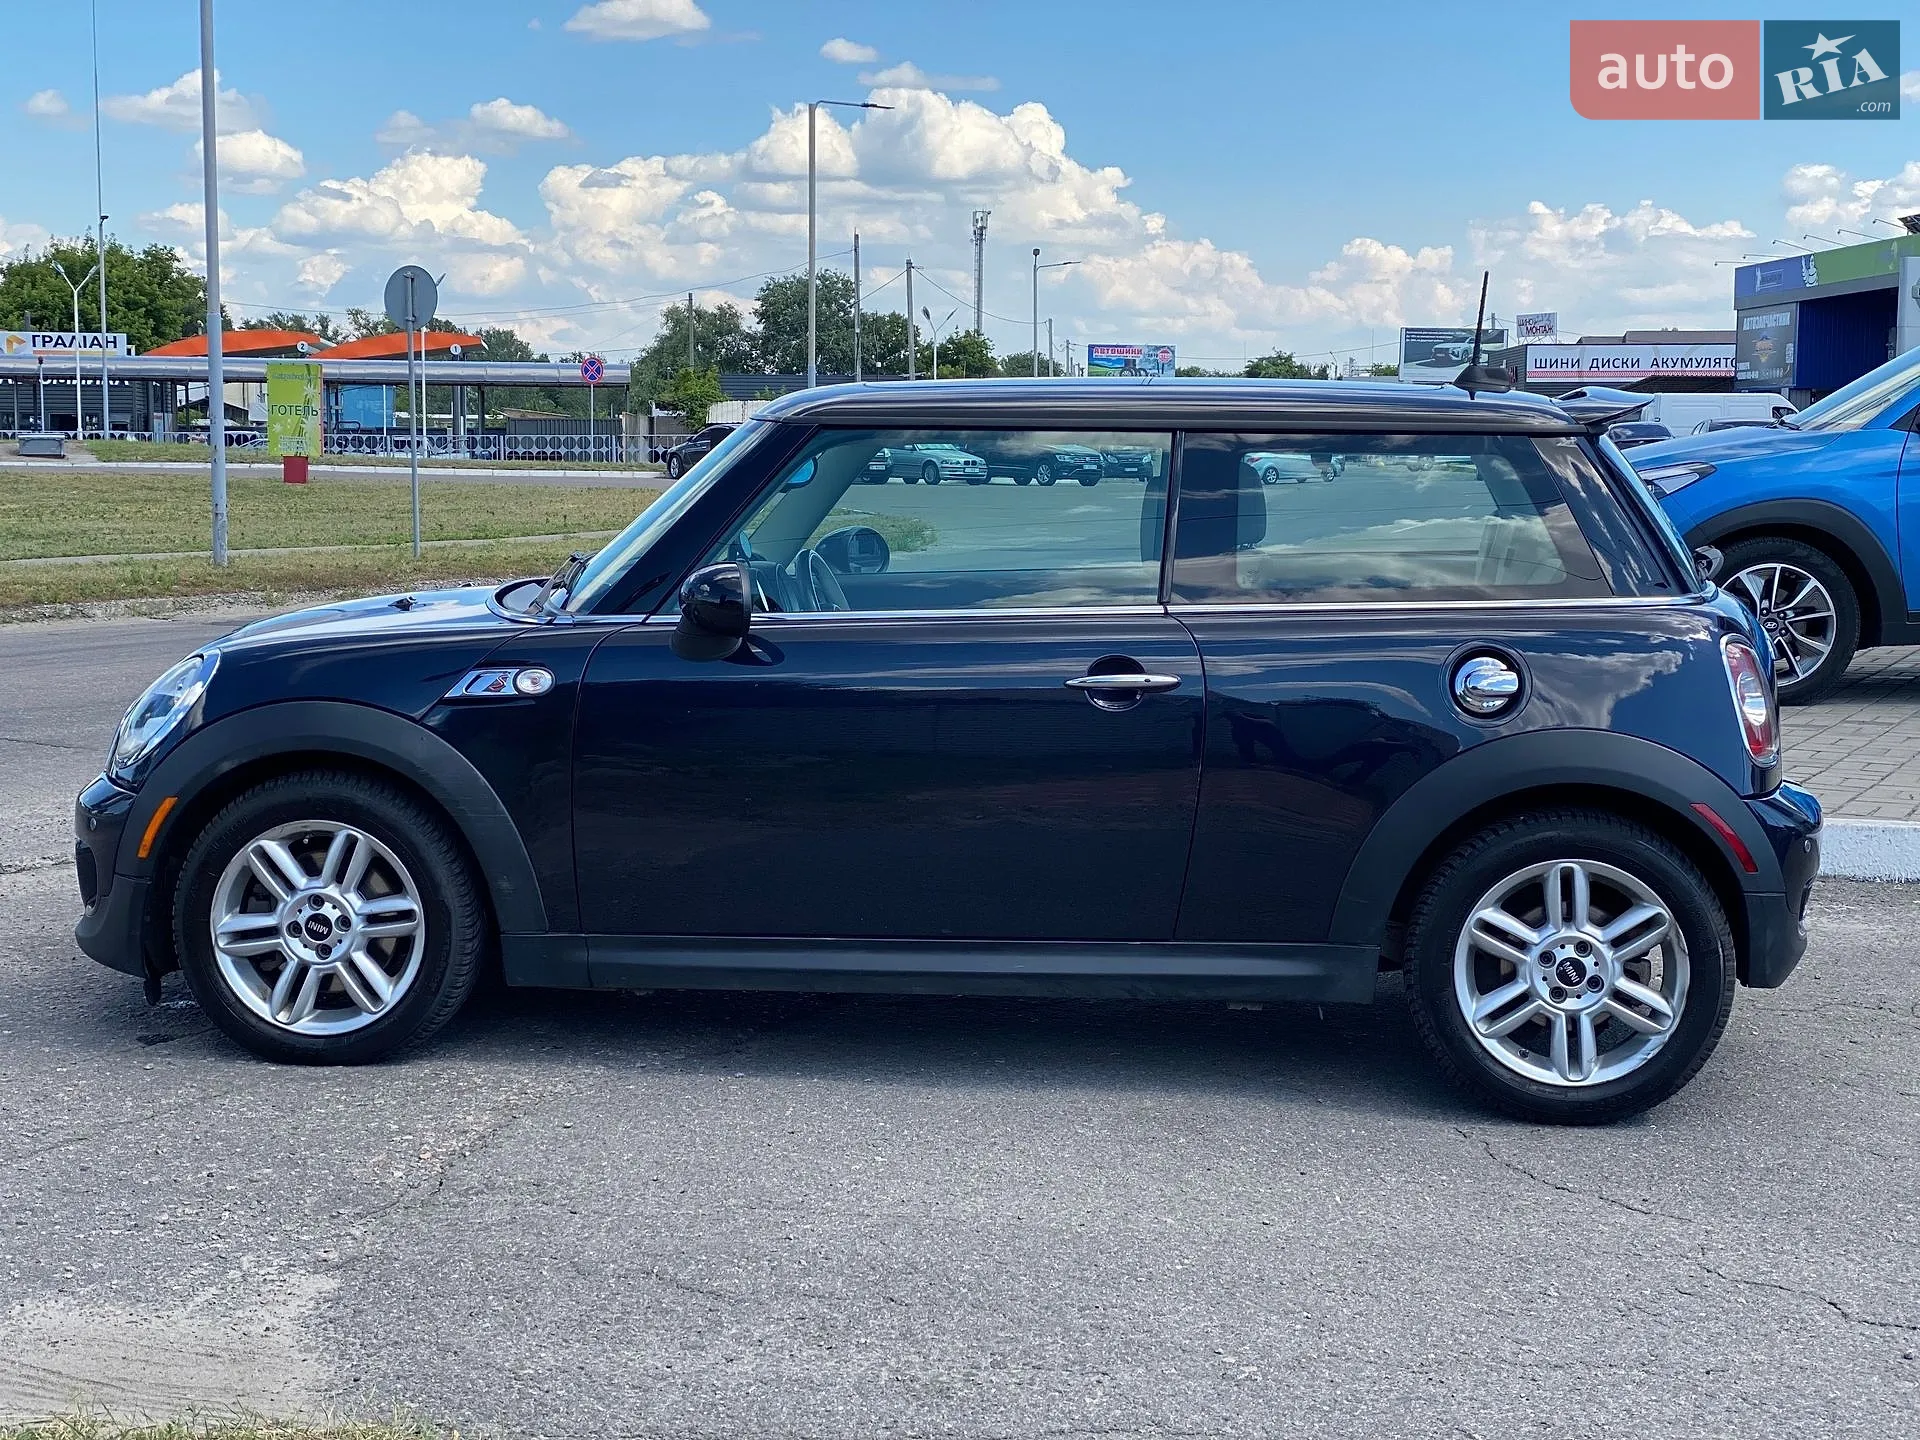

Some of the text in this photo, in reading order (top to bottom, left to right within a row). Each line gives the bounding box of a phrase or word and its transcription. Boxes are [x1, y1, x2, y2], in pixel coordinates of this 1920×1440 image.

[31, 334, 118, 349] ГРАЛІАН
[1534, 357, 1581, 369] ШИНИ
[1589, 357, 1640, 371] ДИСКИ
[271, 404, 319, 416] ГОТЕЛЬ
[307, 920, 329, 934] MINI
[1562, 961, 1580, 982] MINI
